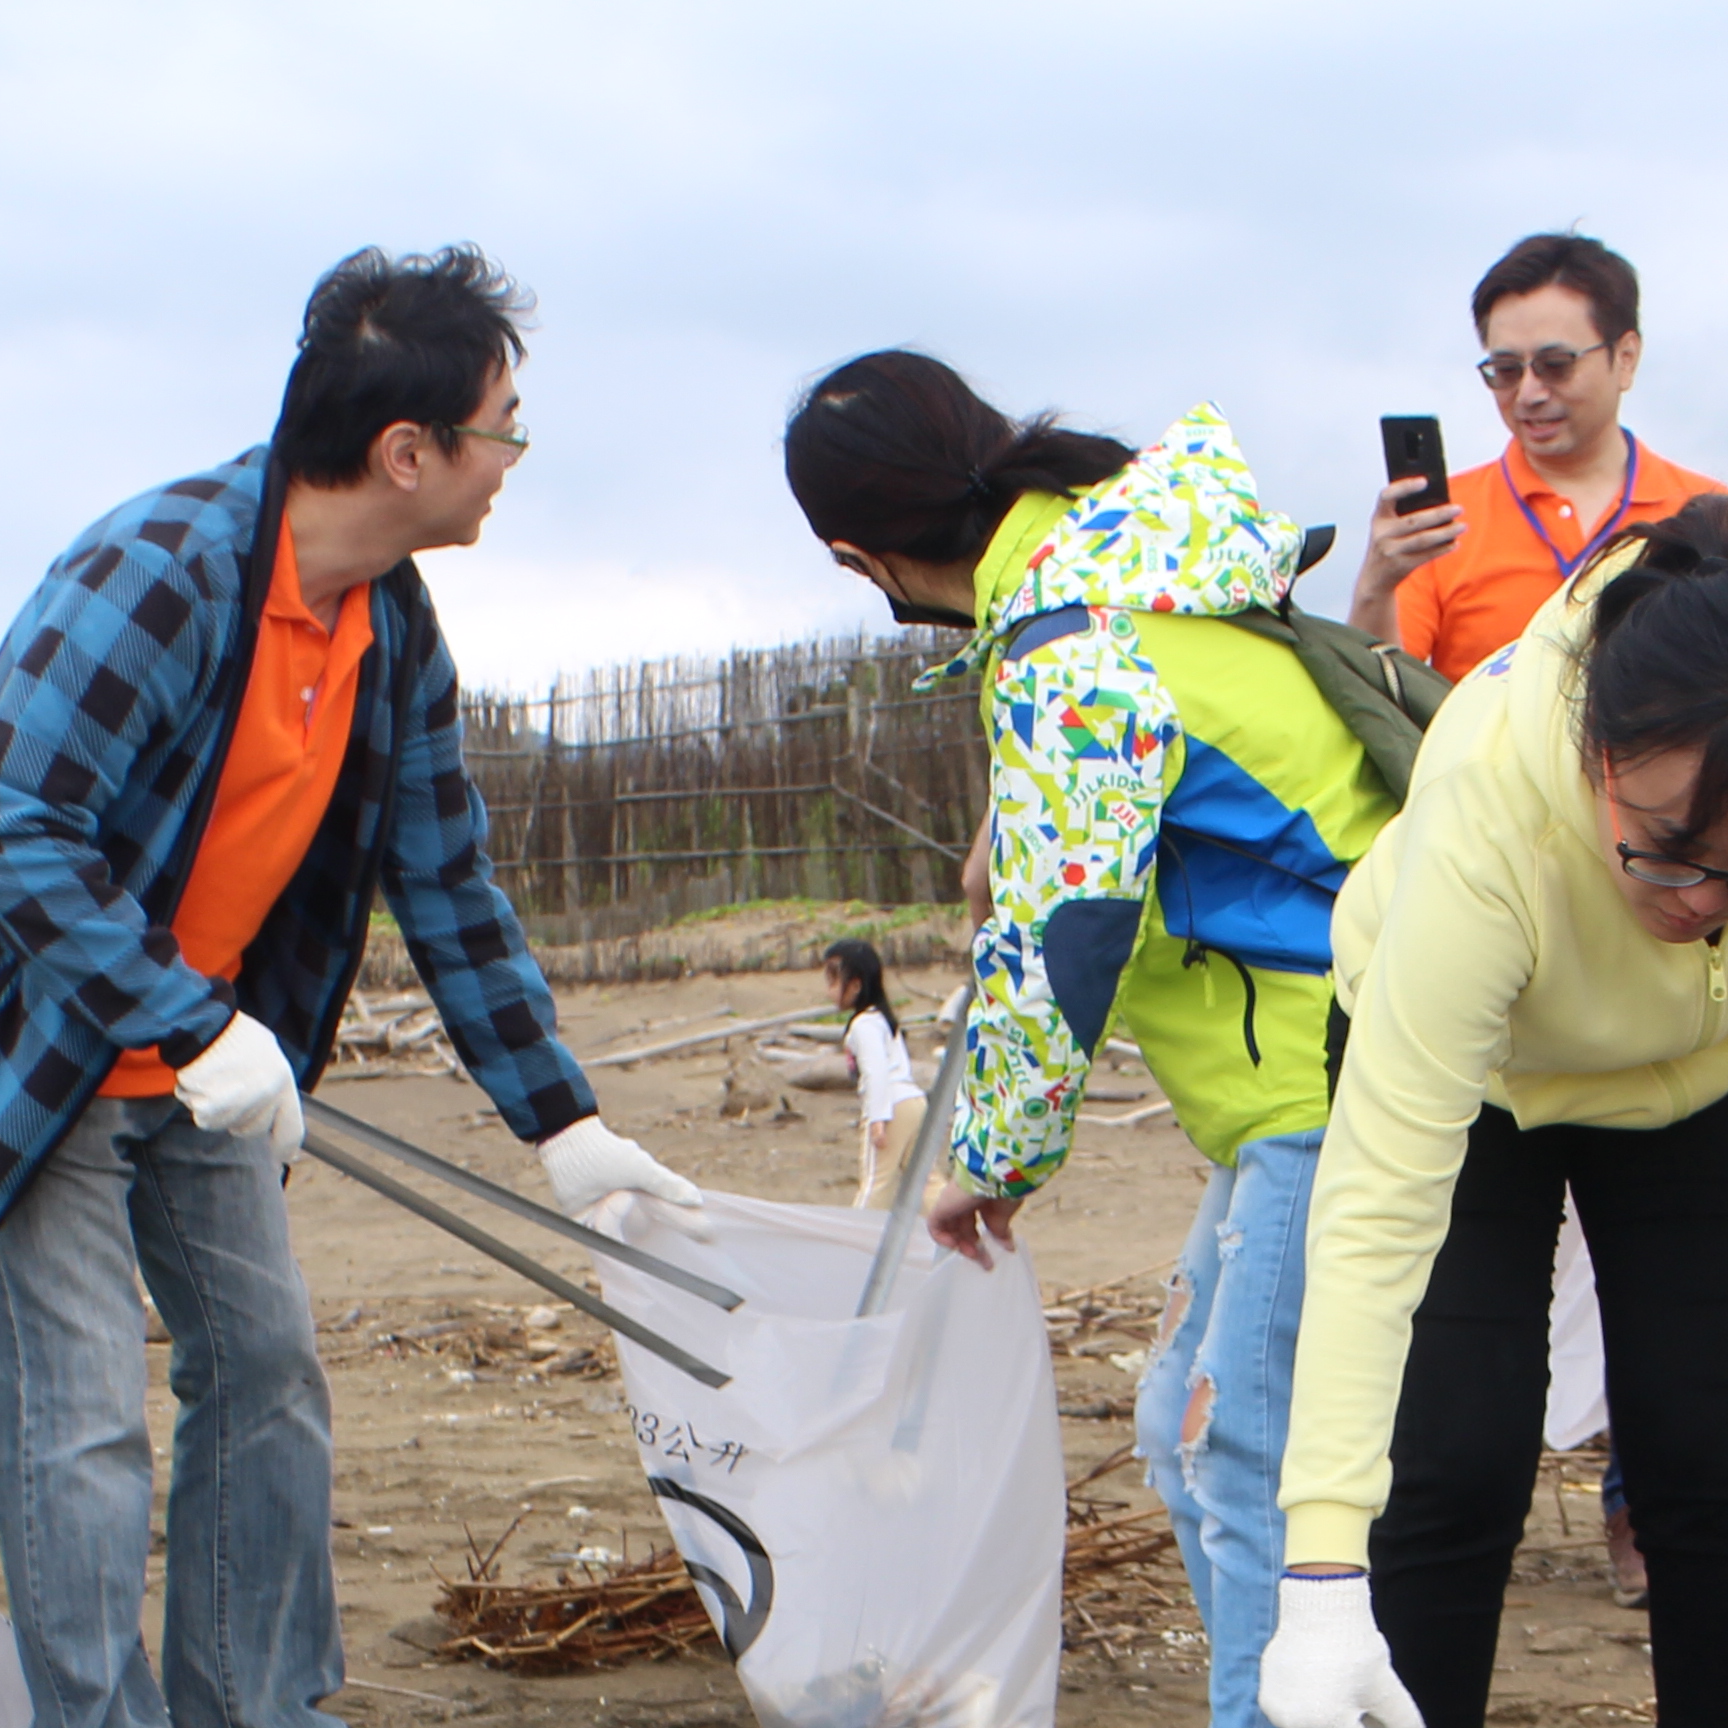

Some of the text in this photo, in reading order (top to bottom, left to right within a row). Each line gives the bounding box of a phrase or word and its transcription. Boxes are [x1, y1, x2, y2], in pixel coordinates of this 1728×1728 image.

[1206, 547, 1270, 592] JJLKIDS
[1071, 773, 1144, 808] JJLKIDS
[1111, 803, 1139, 829] JJL
